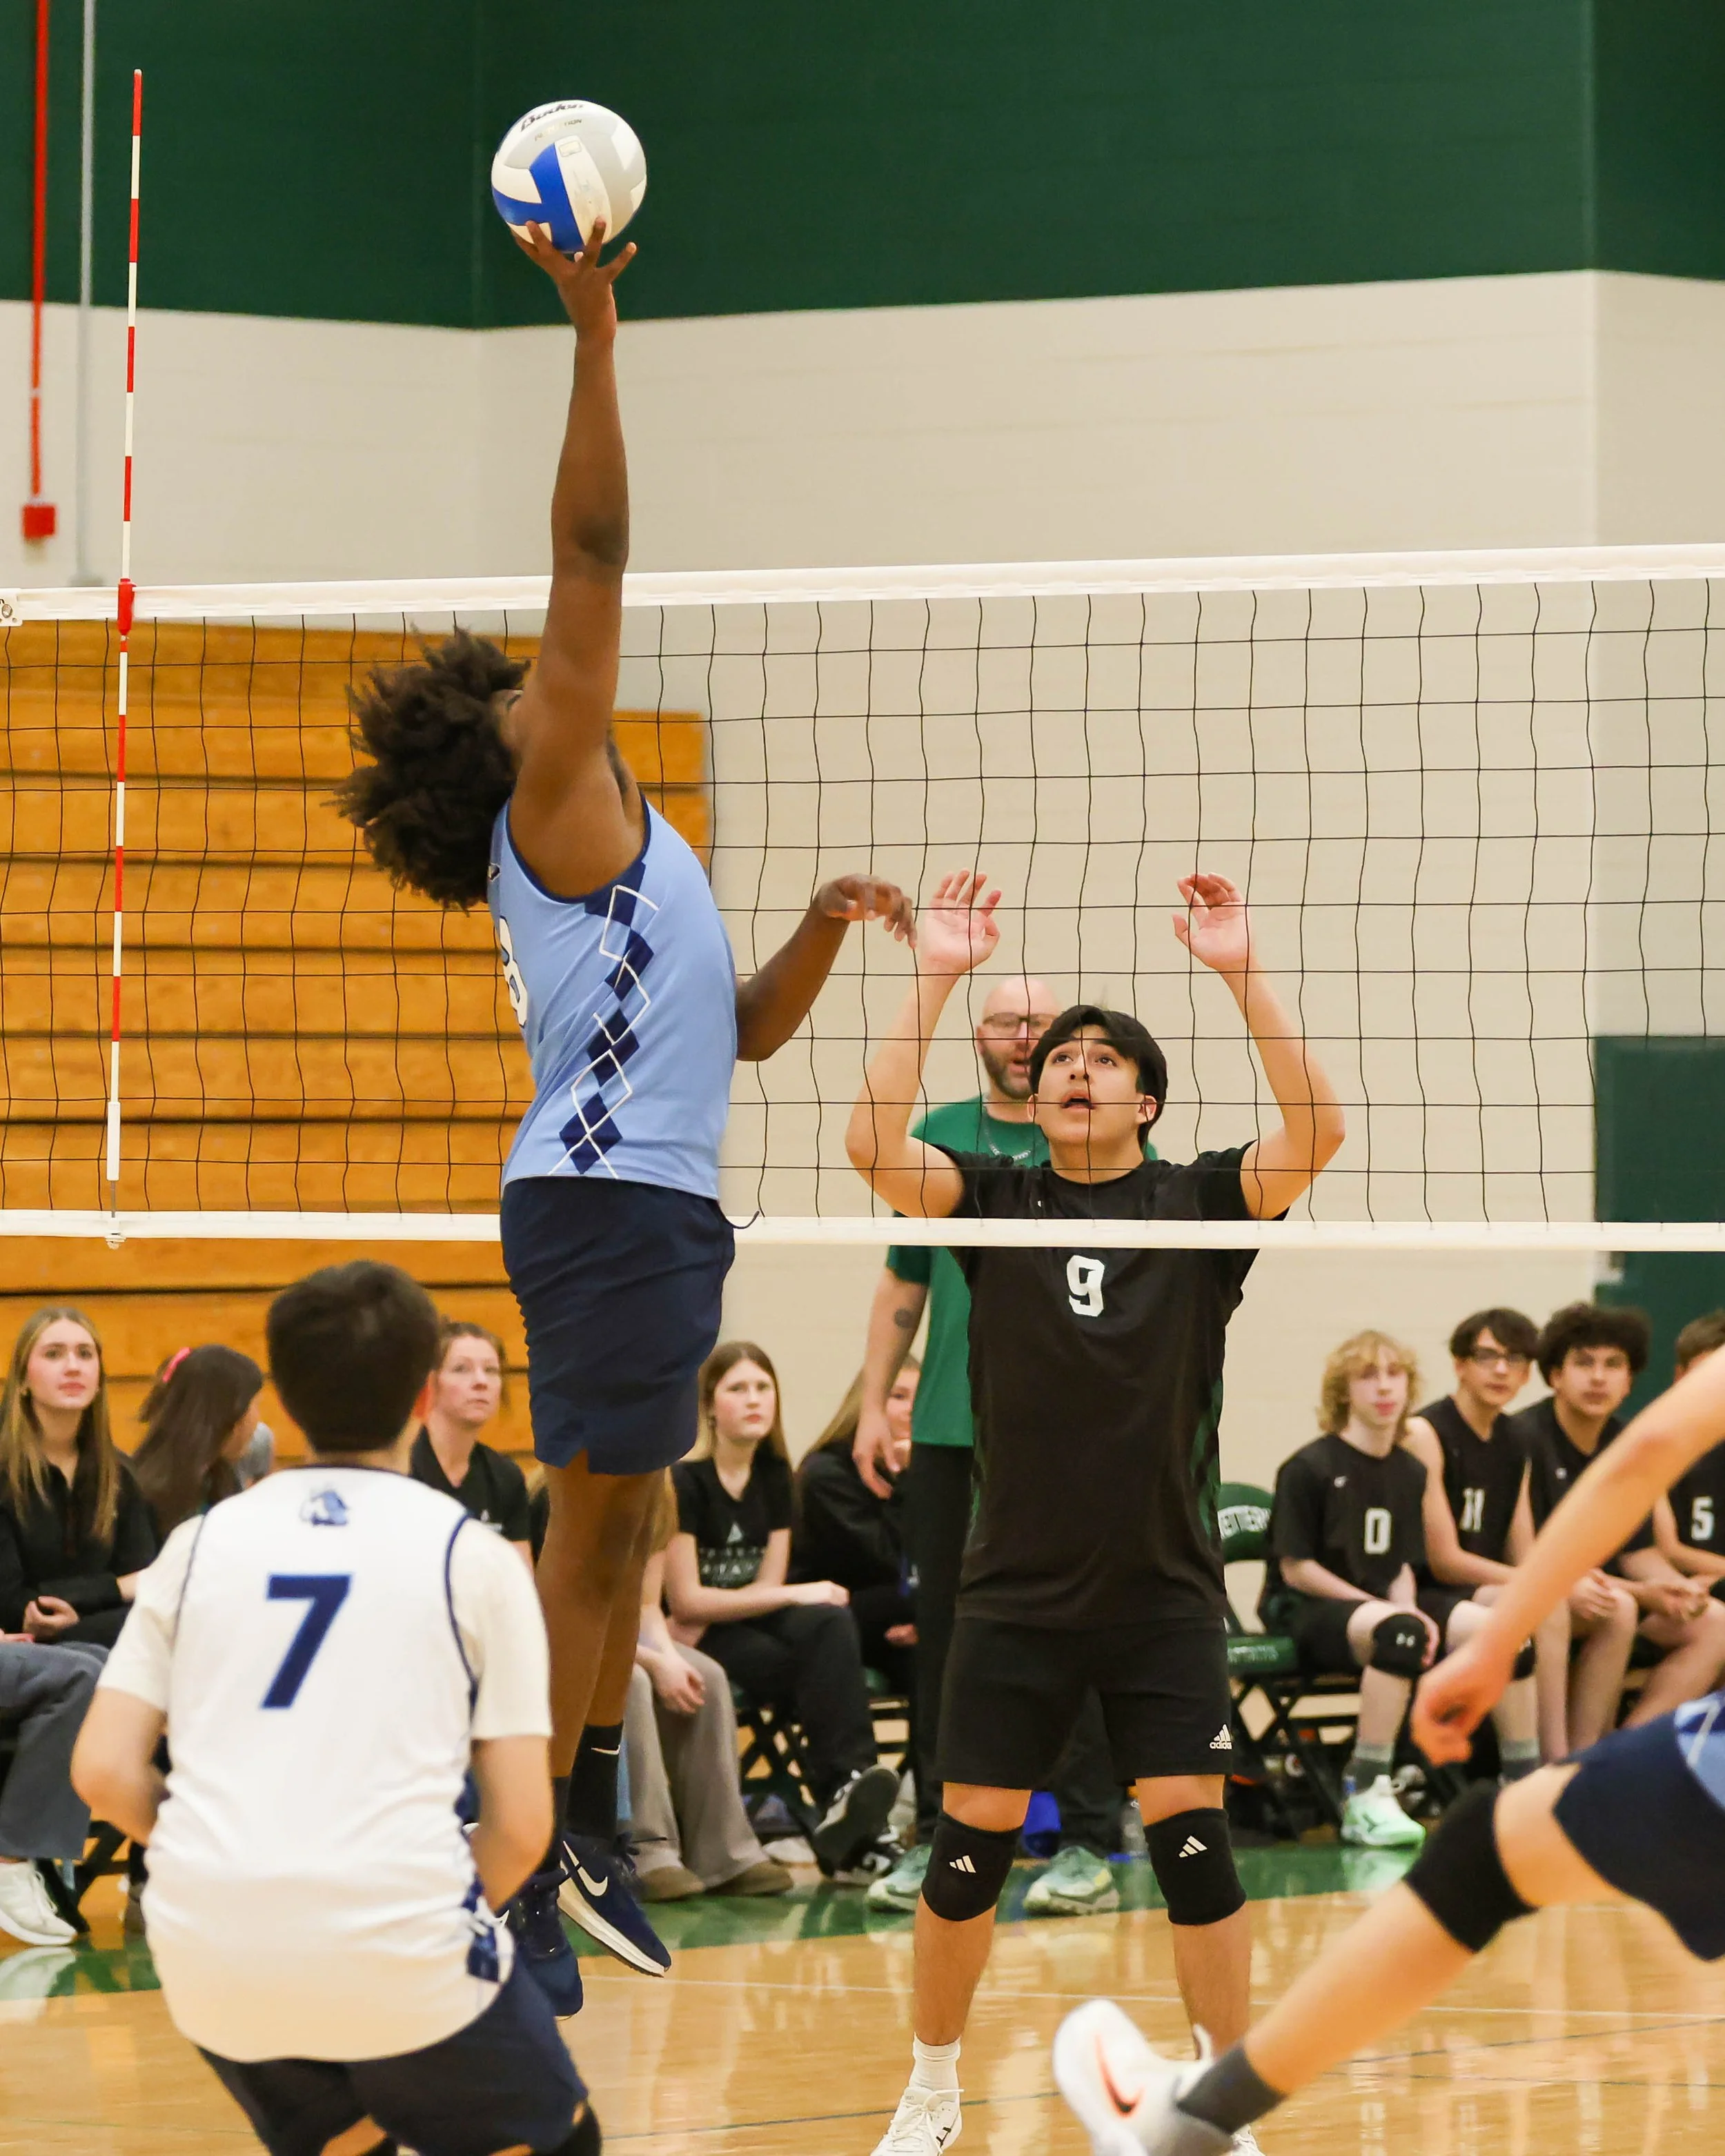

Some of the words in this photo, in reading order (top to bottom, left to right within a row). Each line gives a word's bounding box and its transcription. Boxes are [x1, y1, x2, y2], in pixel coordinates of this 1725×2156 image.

[1066, 1255, 1105, 1317] 9
[1364, 1507, 1392, 1554] 0
[1691, 1495, 1714, 1541] 5
[259, 1572, 353, 1708] 7
